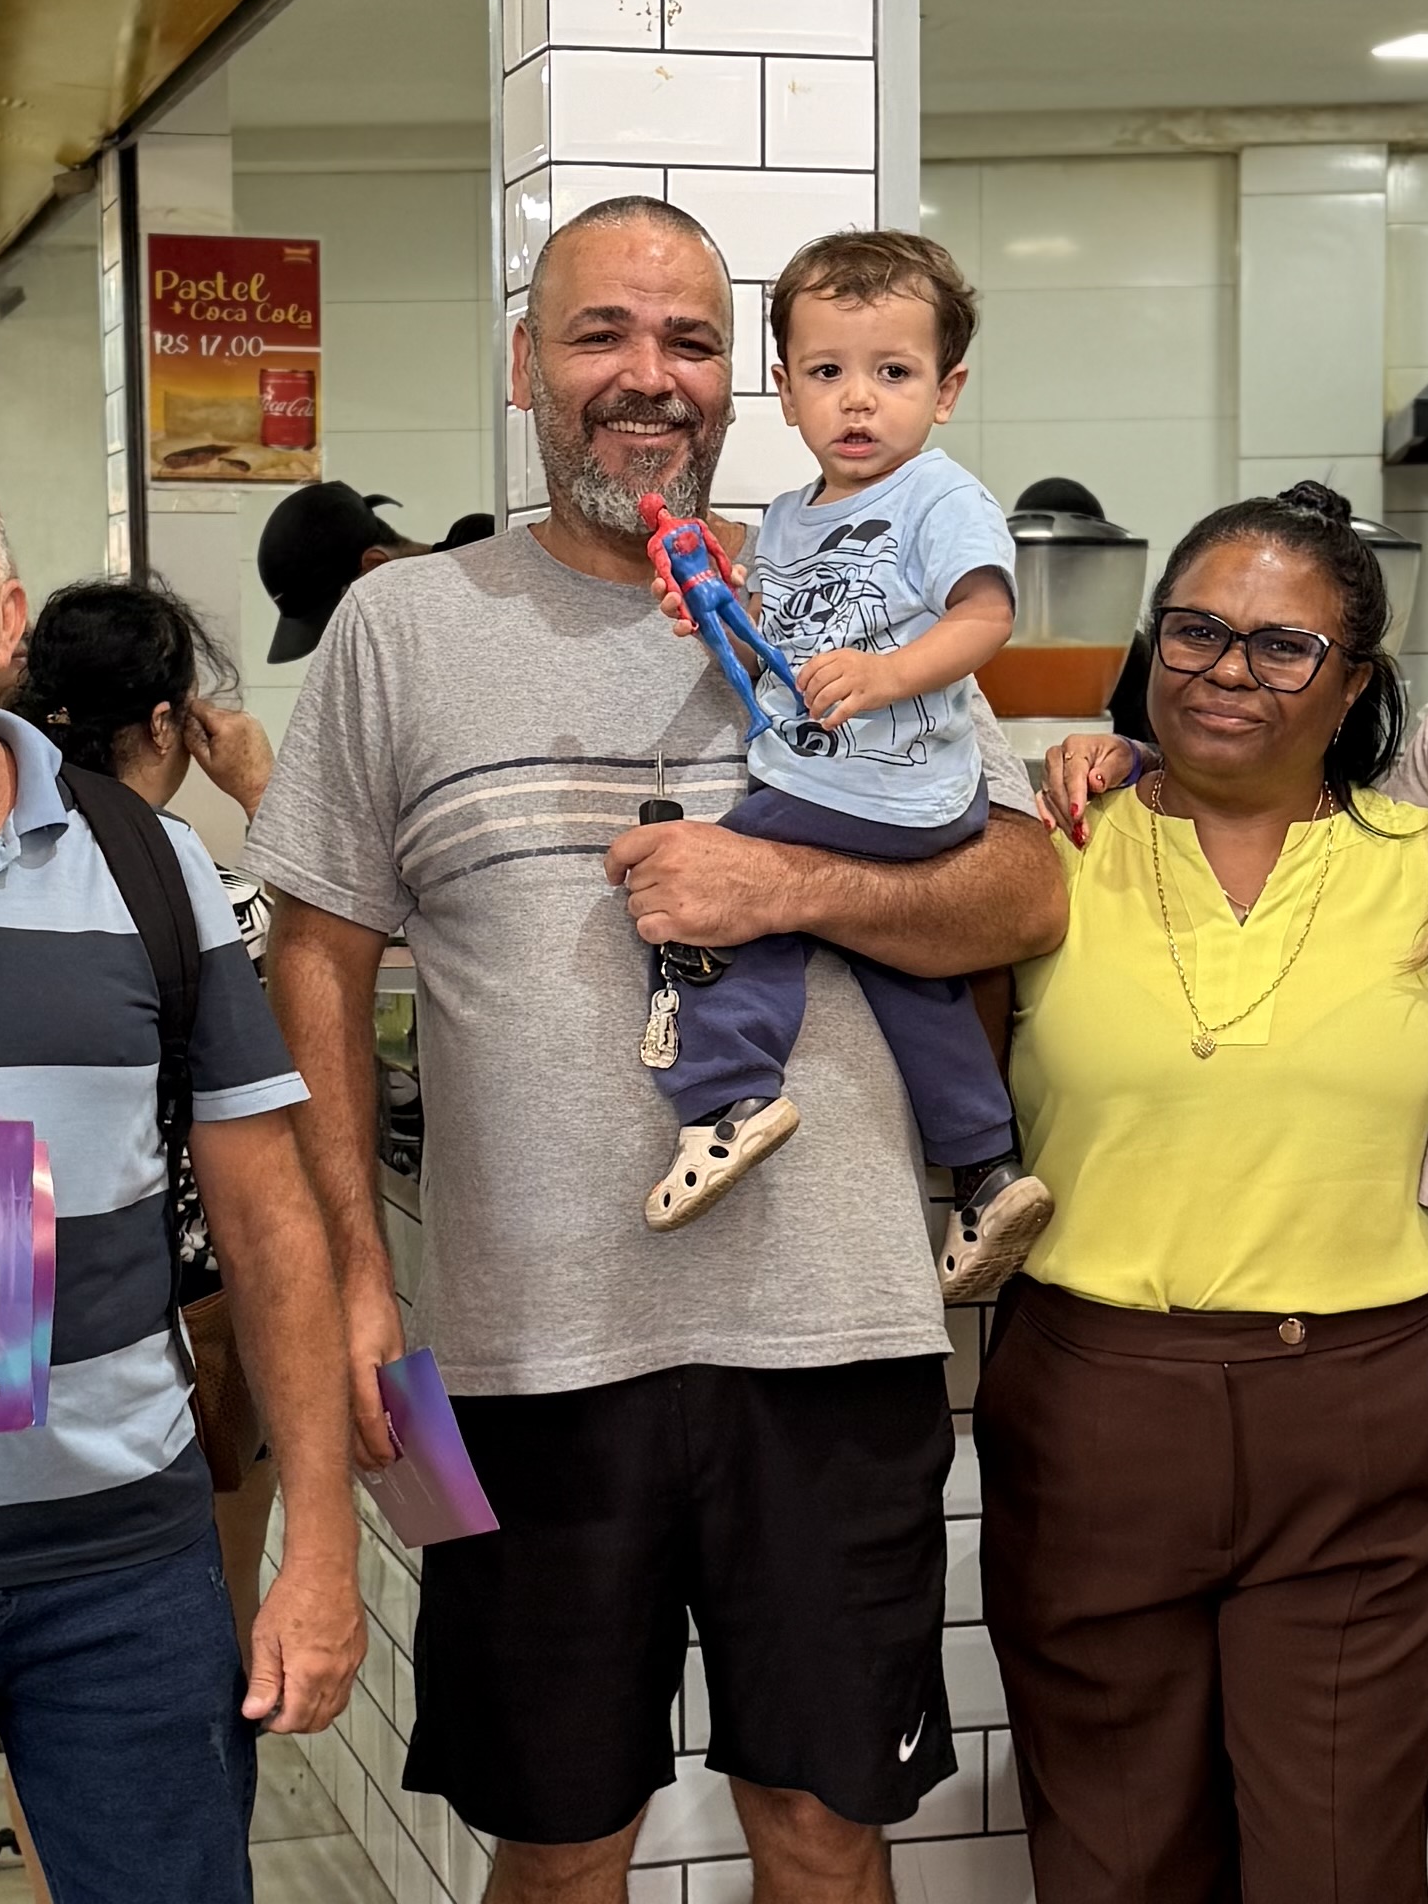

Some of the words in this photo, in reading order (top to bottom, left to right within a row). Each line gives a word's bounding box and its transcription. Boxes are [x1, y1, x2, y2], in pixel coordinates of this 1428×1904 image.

[155, 270, 271, 302] Pastel
[191, 300, 248, 322] Coca
[256, 303, 313, 327] Cola
